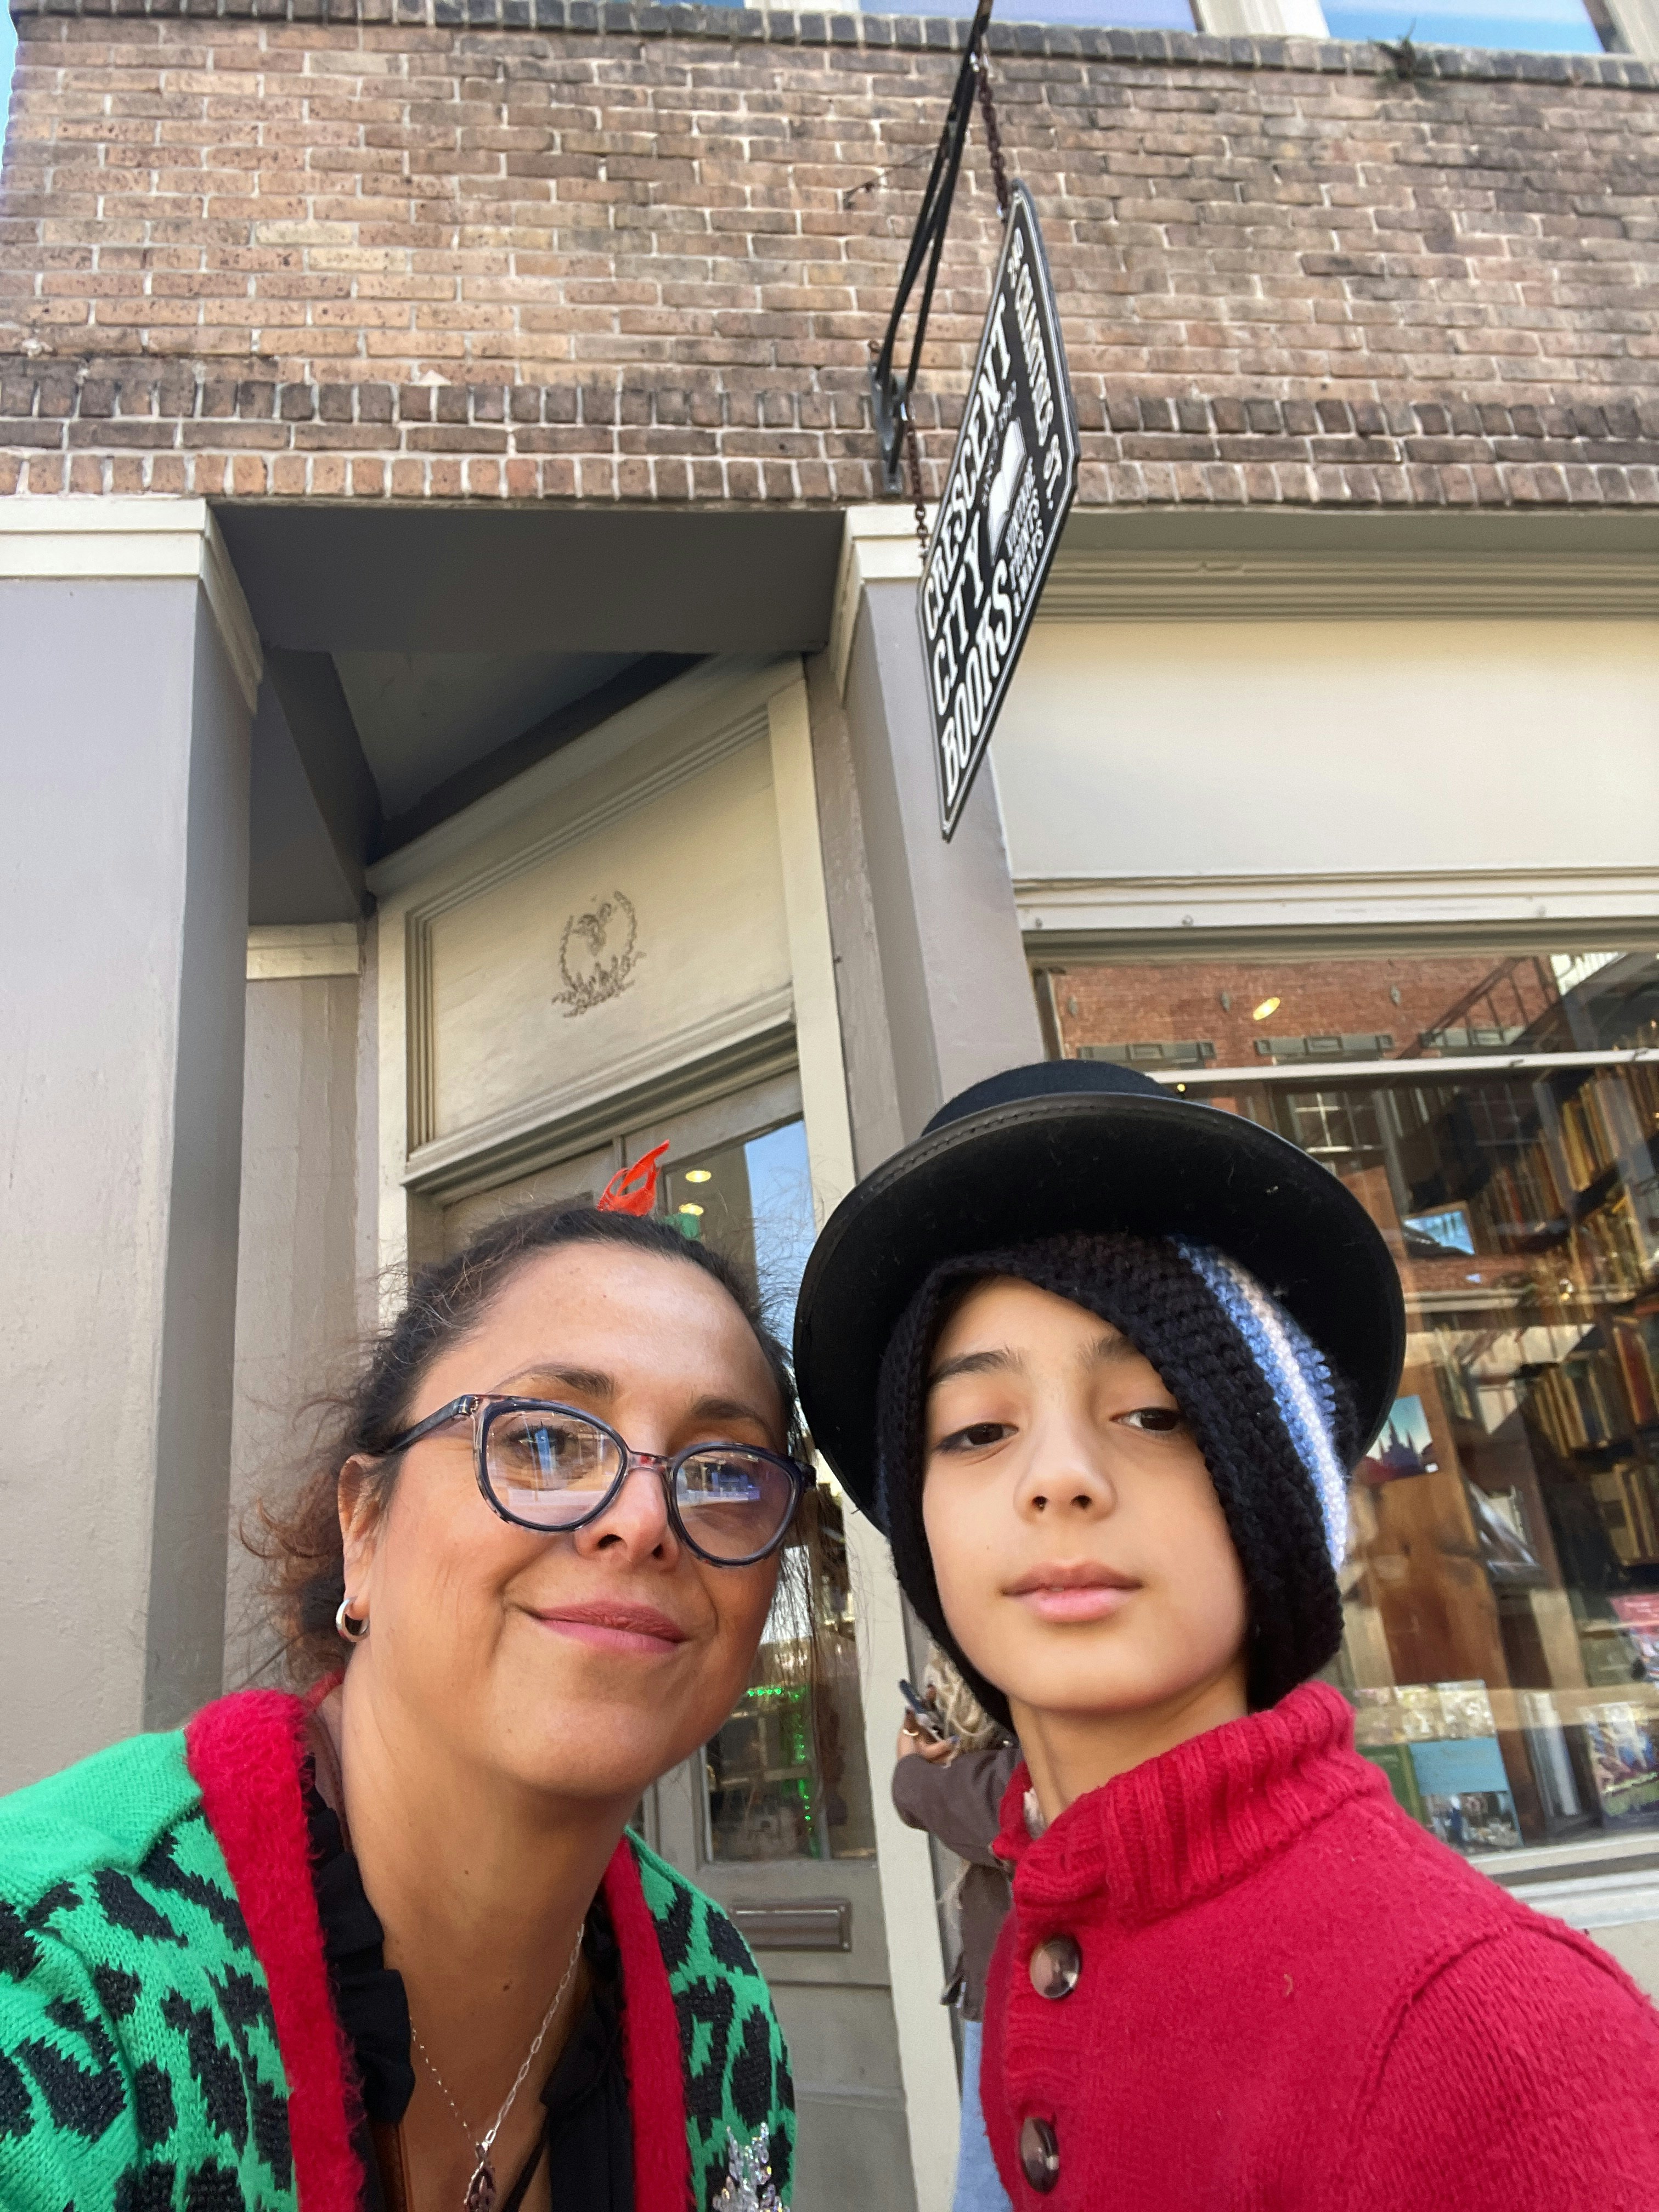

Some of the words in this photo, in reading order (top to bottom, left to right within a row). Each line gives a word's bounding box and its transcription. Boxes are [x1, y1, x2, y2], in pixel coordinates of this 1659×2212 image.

[924, 292, 1011, 640] CRESCENT
[933, 511, 984, 716] CITY
[941, 559, 1012, 807] BOOKS
